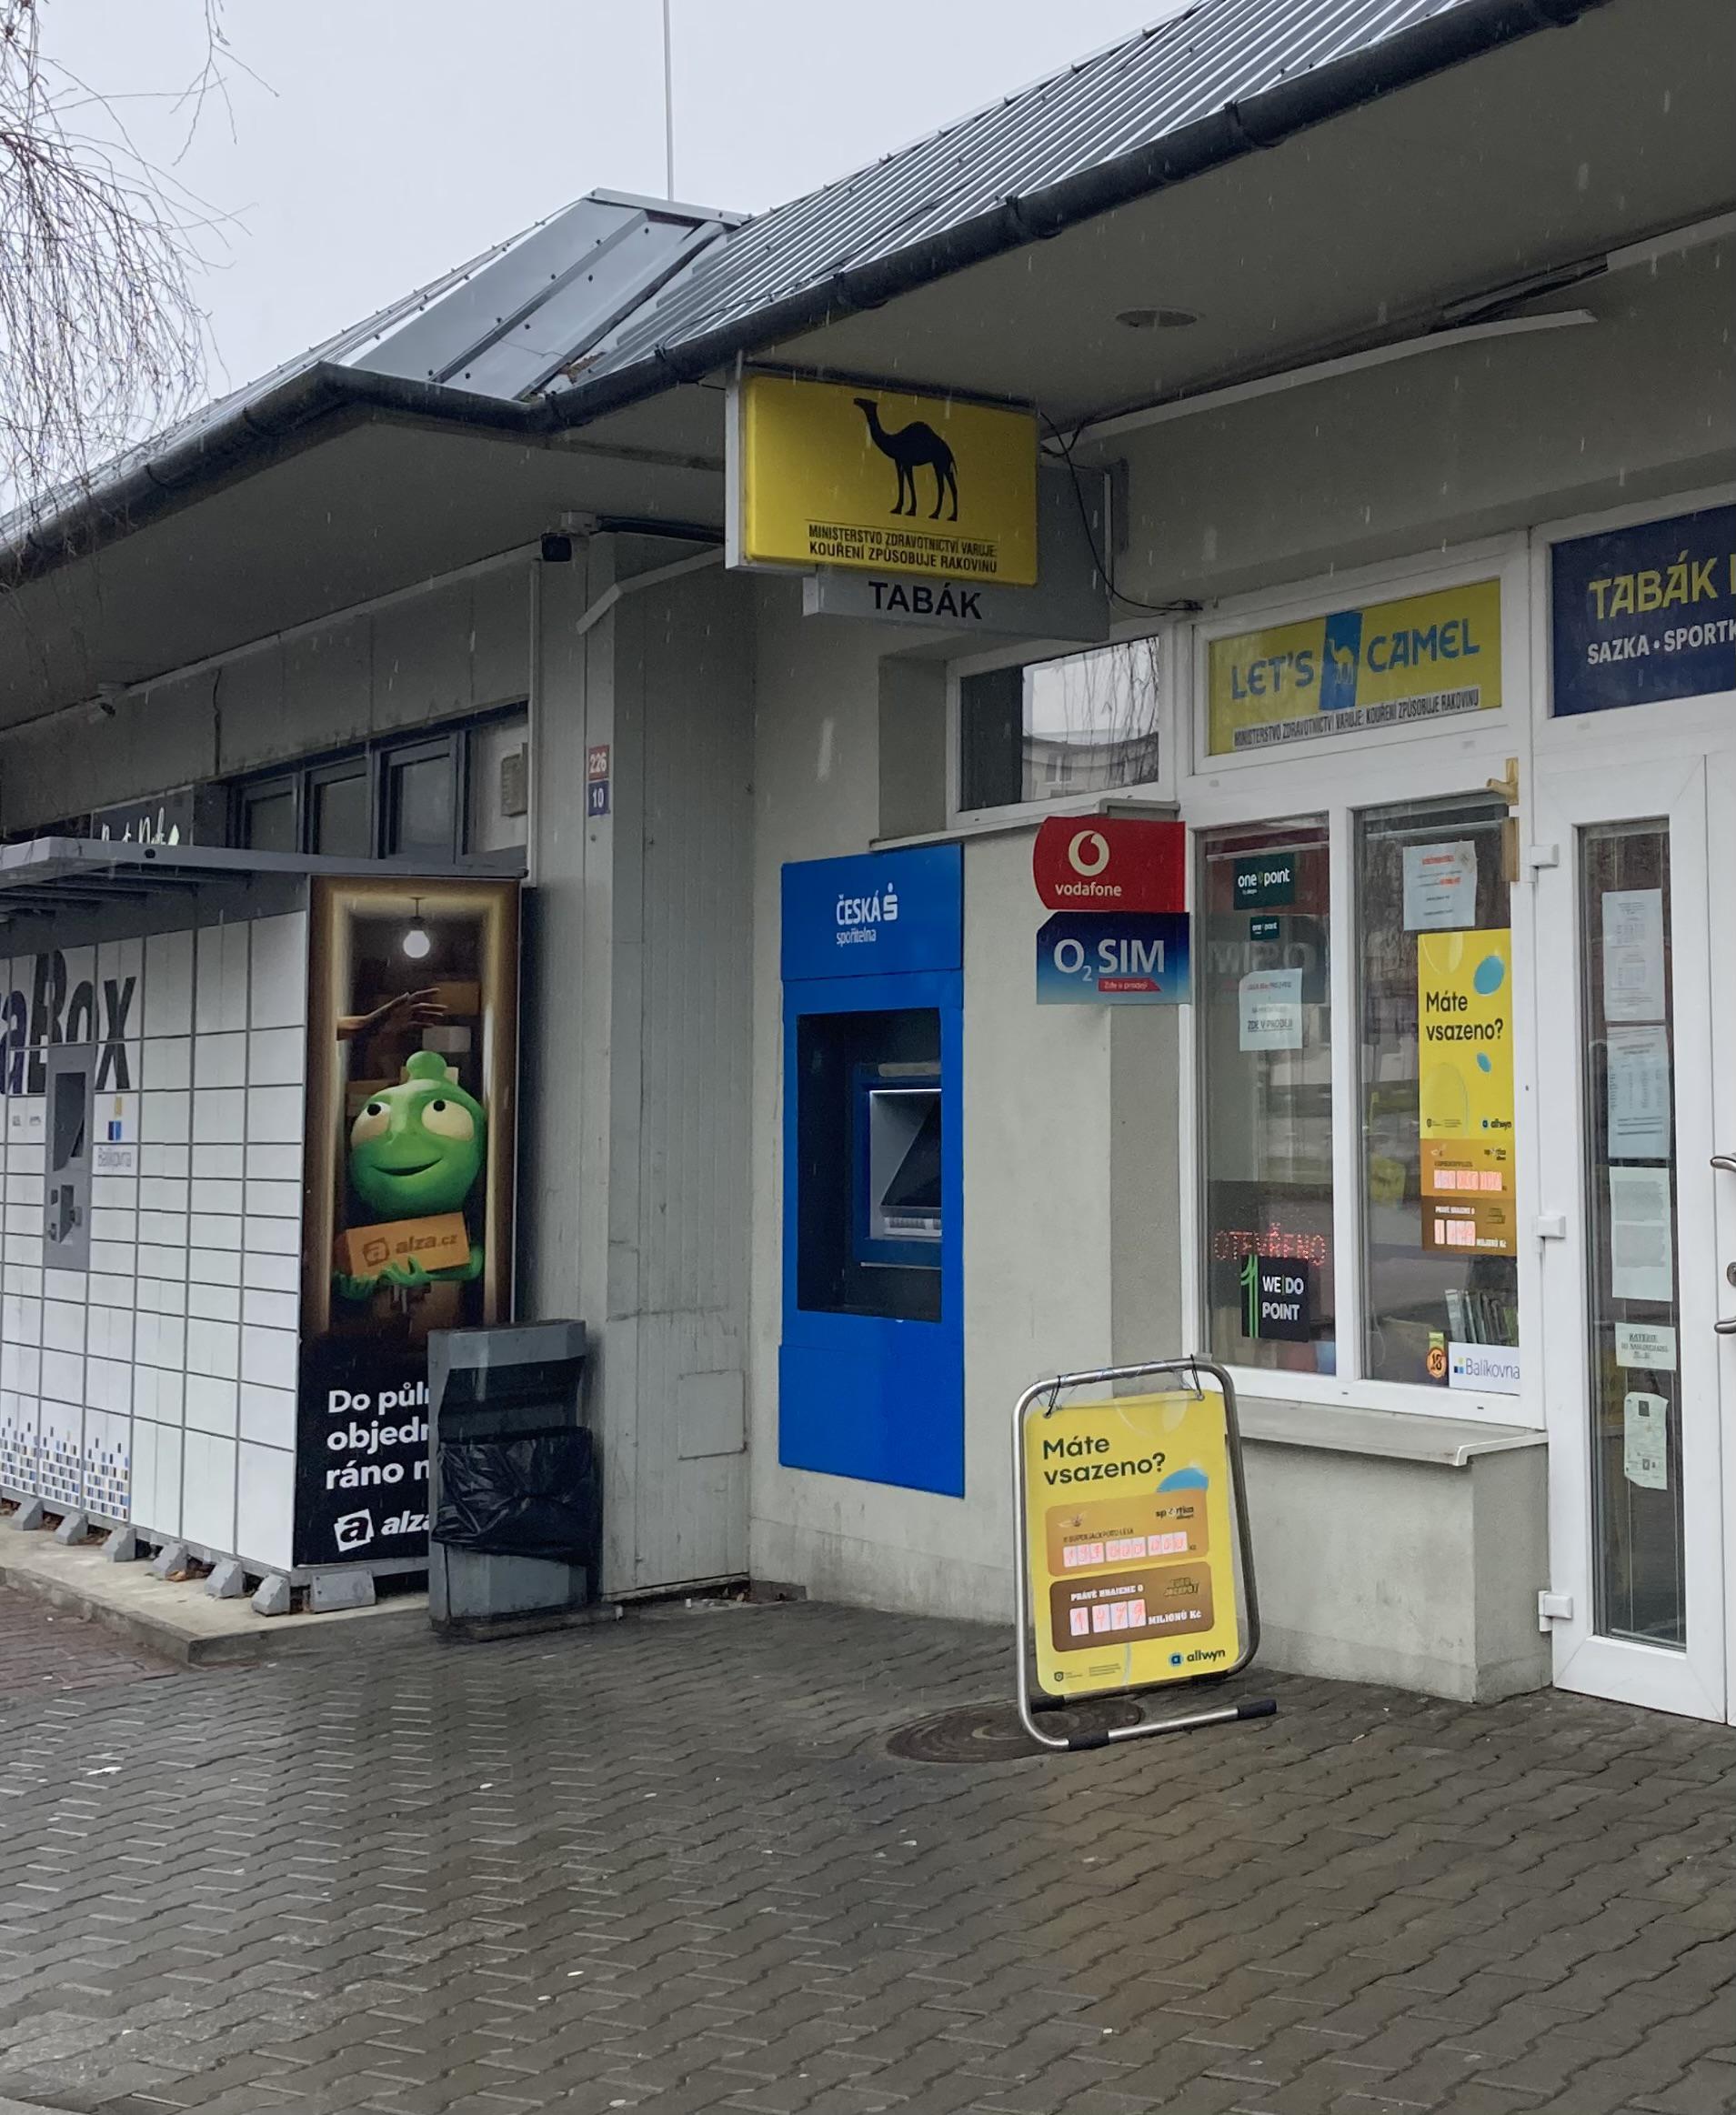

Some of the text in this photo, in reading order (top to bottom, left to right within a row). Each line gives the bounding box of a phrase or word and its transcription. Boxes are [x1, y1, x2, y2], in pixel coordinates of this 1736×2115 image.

[809, 525, 882, 544] MINISTERSTVO
[886, 533, 958, 554] ZDRAVOTNICTVÍ
[810, 541, 997, 573] KOUŘENÍ ZPŮSOBUJE RAKOVINU
[1588, 549, 1719, 620] TABÁK
[868, 581, 982, 620] TABÁK
[1231, 618, 1480, 699] LET'S CAMEL
[1587, 635, 1650, 665] SAZKA
[1441, 688, 1480, 709] RAKOVINU
[589, 752, 607, 773] 226
[593, 787, 604, 808] 10
[1238, 867, 1290, 887] one point
[1055, 881, 1122, 897] vodafone
[837, 889, 881, 926] ČESKÁ
[837, 926, 877, 947] spořitelna
[1098, 938, 1164, 974] SIM
[1426, 991, 1468, 1013] Máte
[1426, 1018, 1503, 1041] vsazeno?
[396, 1235, 457, 1254] alza.cz
[1261, 1301, 1300, 1320] POINT
[328, 1389, 371, 1413] Do
[1043, 1436, 1109, 1459] Máte
[326, 1459, 405, 1489] ráno
[1044, 1452, 1166, 1485] vsazeno?
[1187, 1649, 1226, 1662] allwyn
